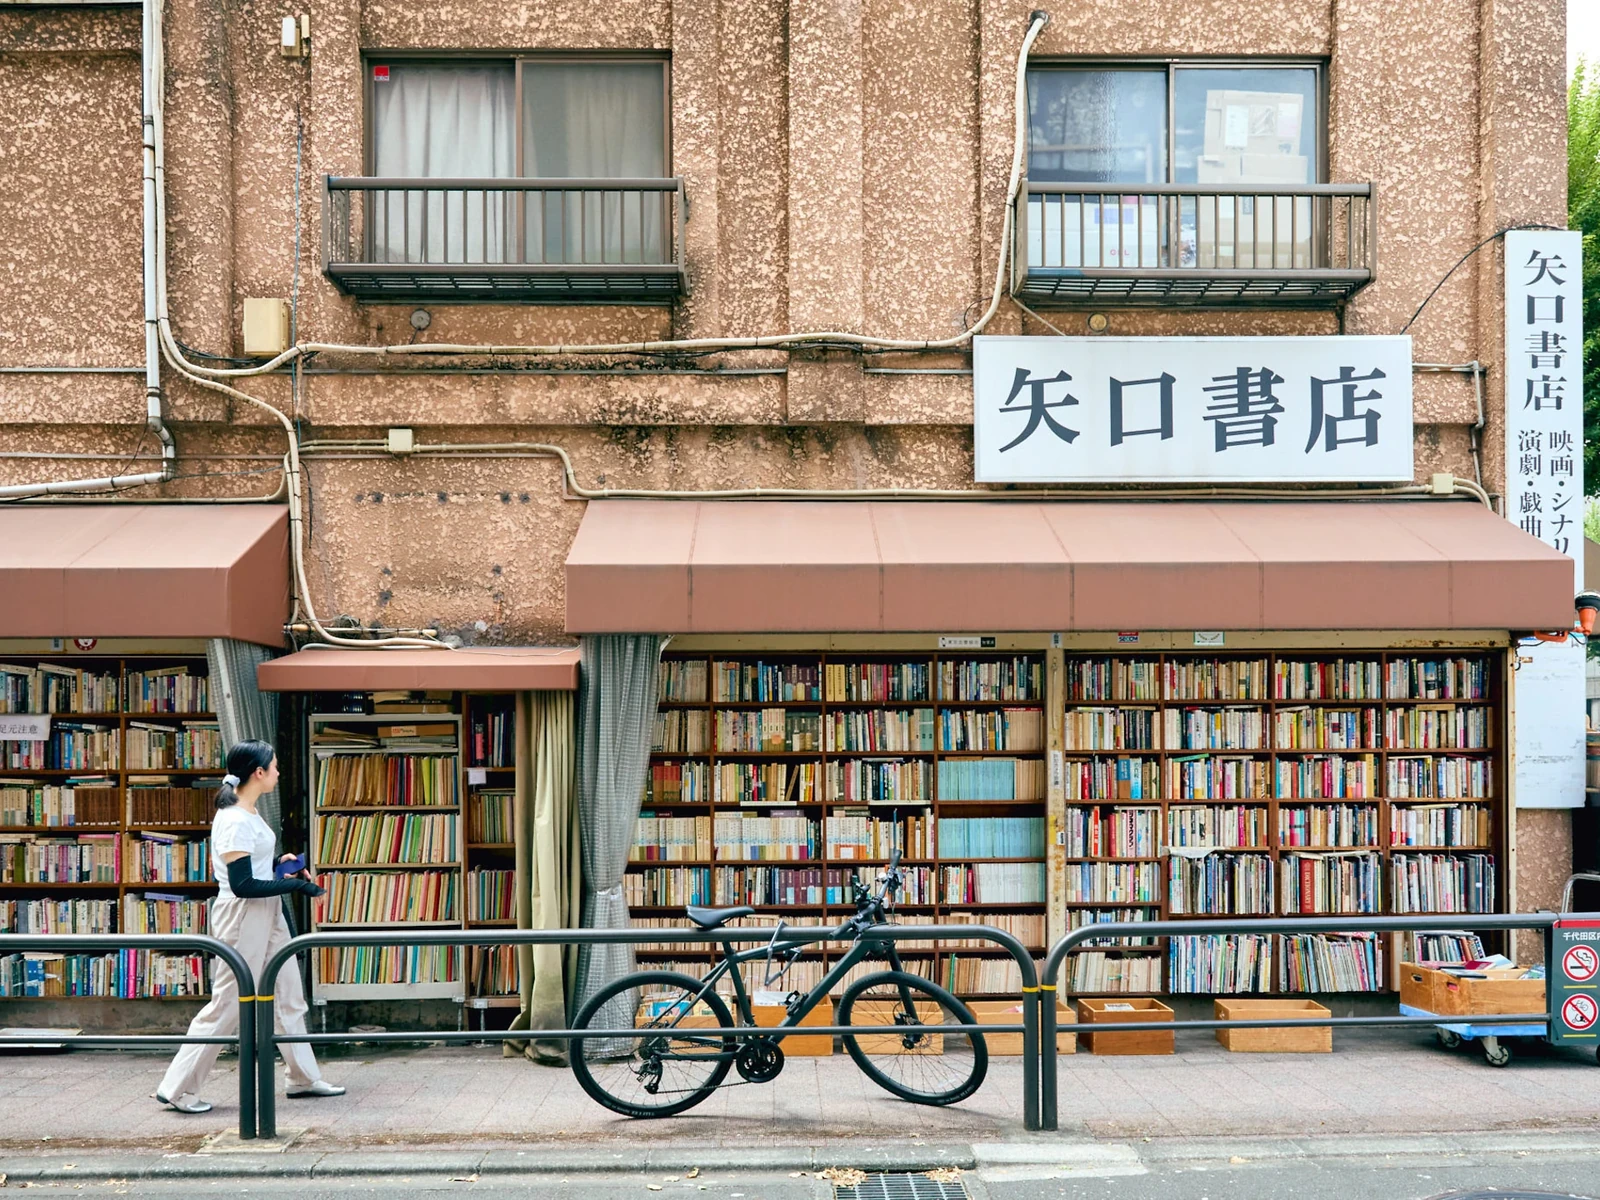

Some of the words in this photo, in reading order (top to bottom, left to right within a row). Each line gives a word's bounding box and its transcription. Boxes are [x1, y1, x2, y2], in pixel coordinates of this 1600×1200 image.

[1523, 249, 1568, 411] 矢口書店
[998, 366, 1387, 455] 矢口書店
[1518, 429, 1544, 538] 演劇・戯曲
